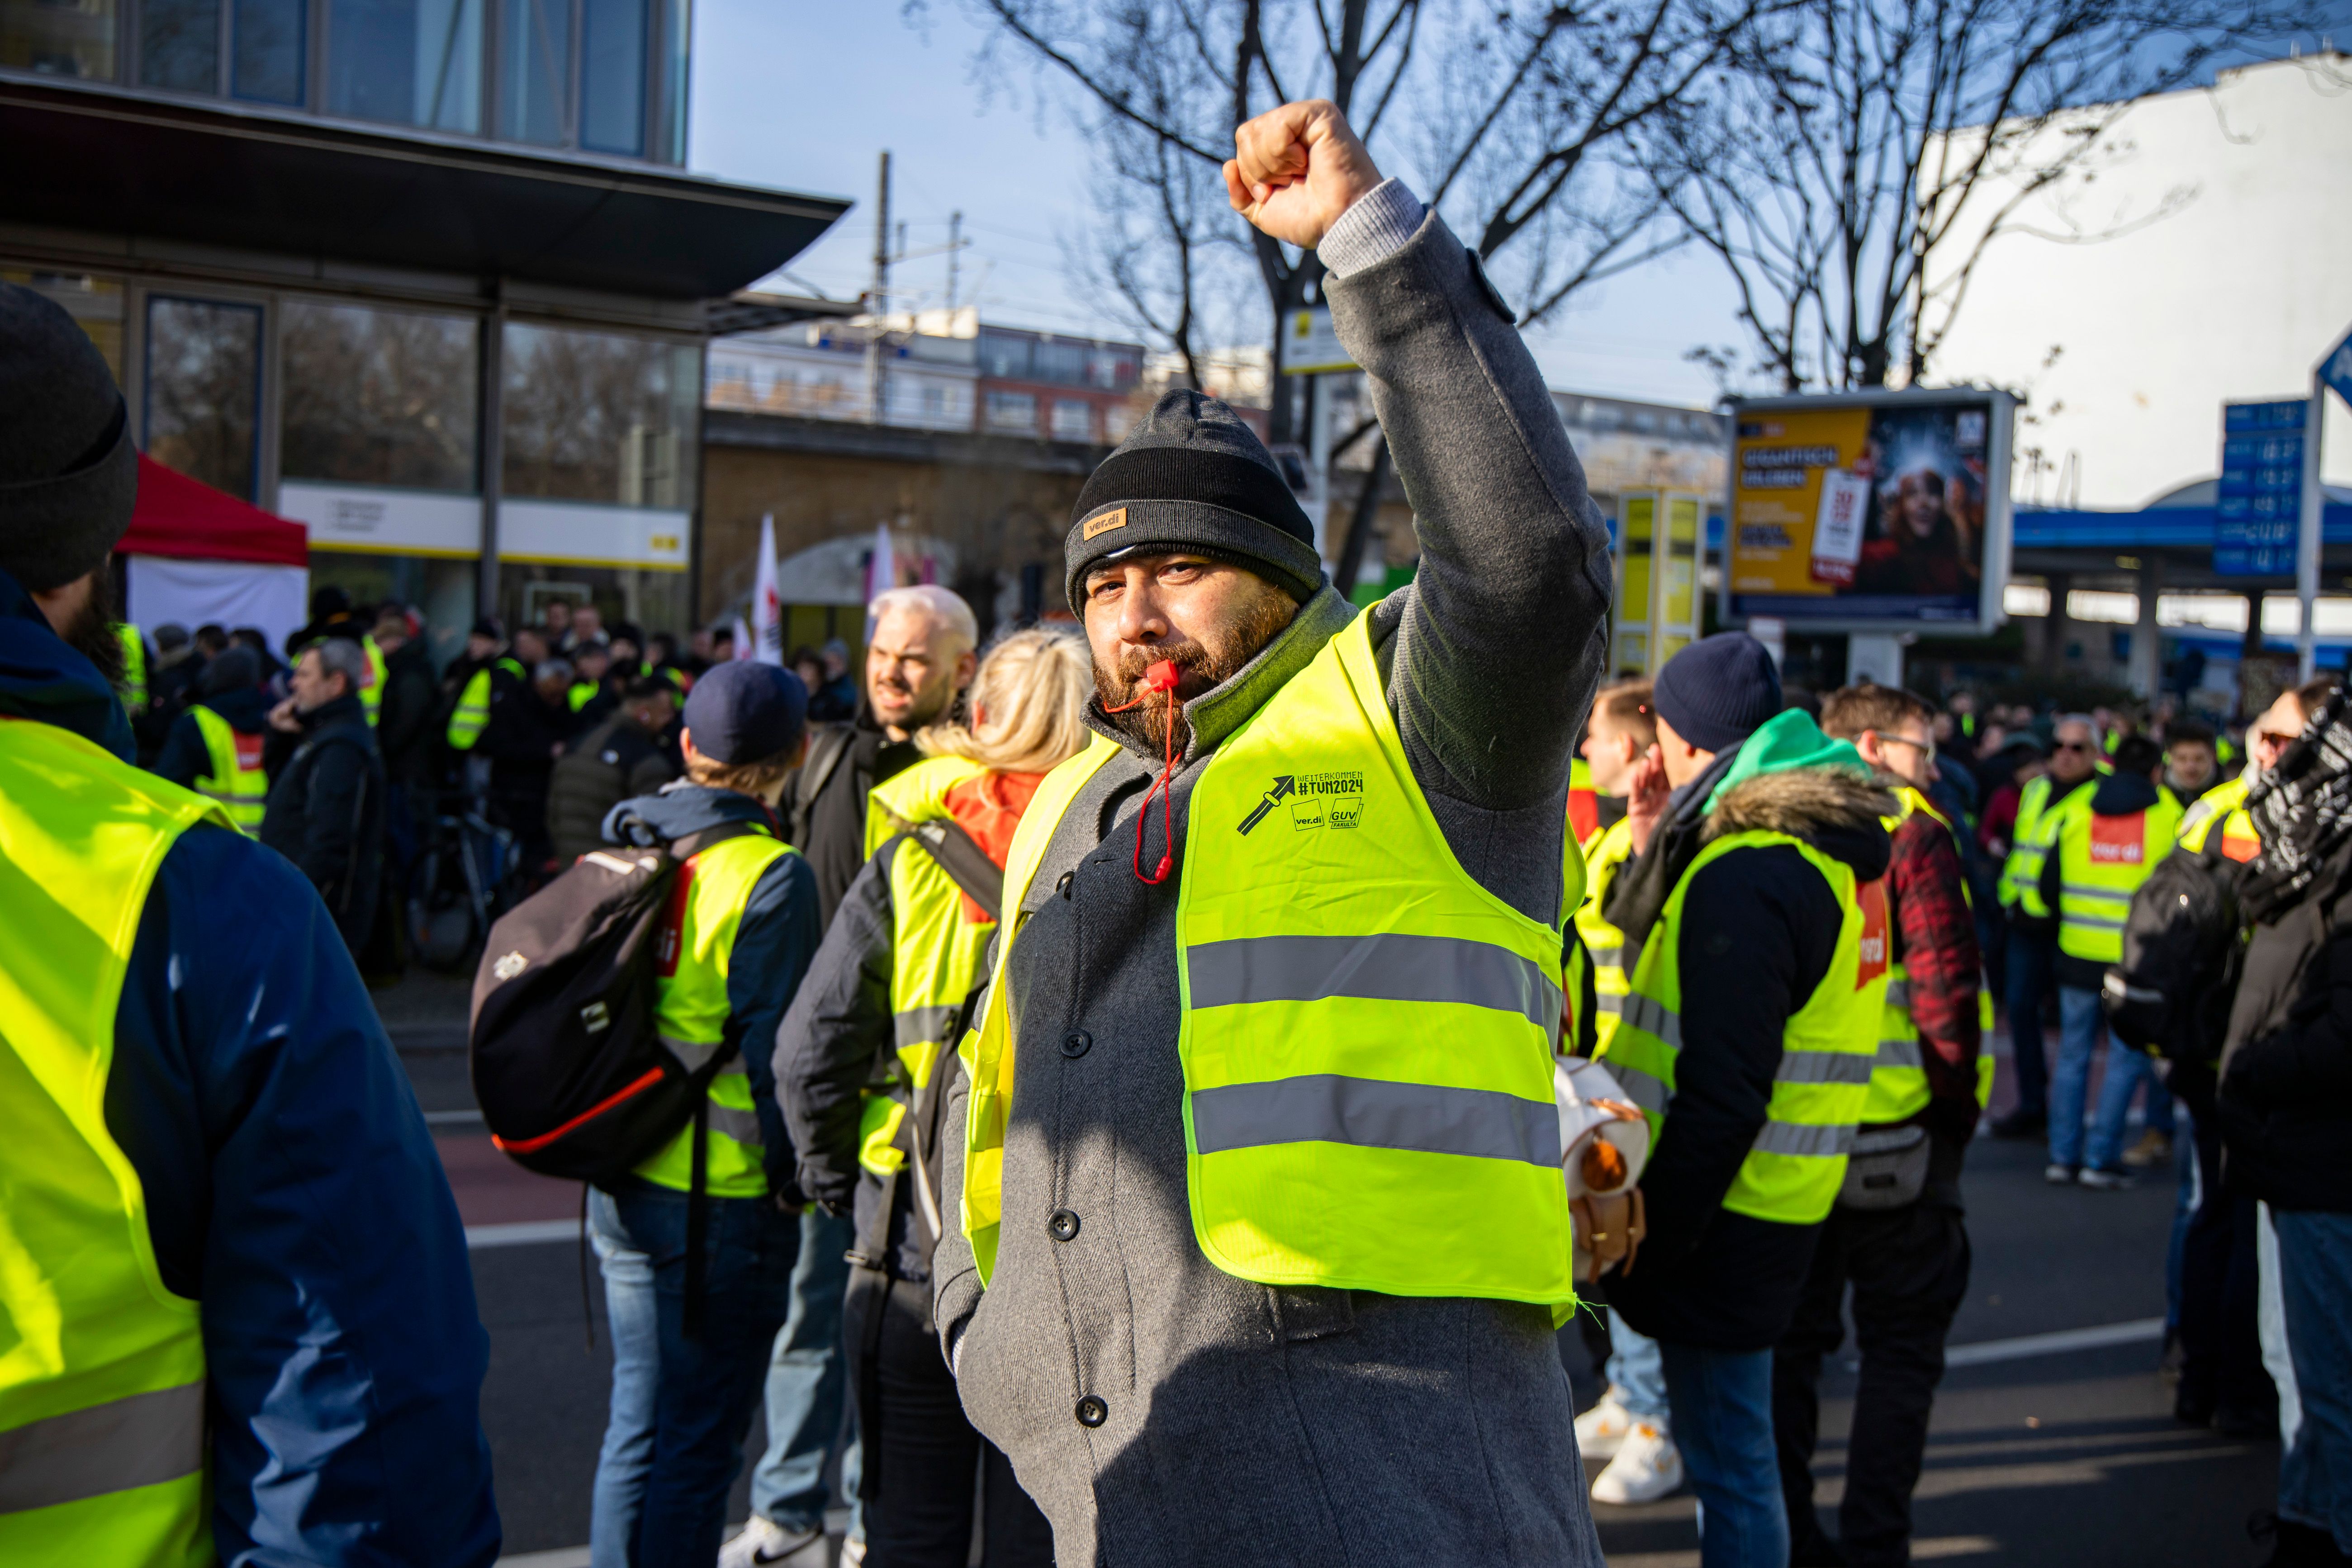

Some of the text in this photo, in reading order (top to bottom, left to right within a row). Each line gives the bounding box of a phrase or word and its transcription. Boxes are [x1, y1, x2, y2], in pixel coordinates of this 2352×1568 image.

[1089, 513, 1119, 532] ver.di
[1298, 771, 1363, 782] WEITERKOMMEN
[1298, 779, 1363, 796] #TVN2024
[1296, 816, 1321, 824] ver.di
[1332, 811, 1356, 820] GUV
